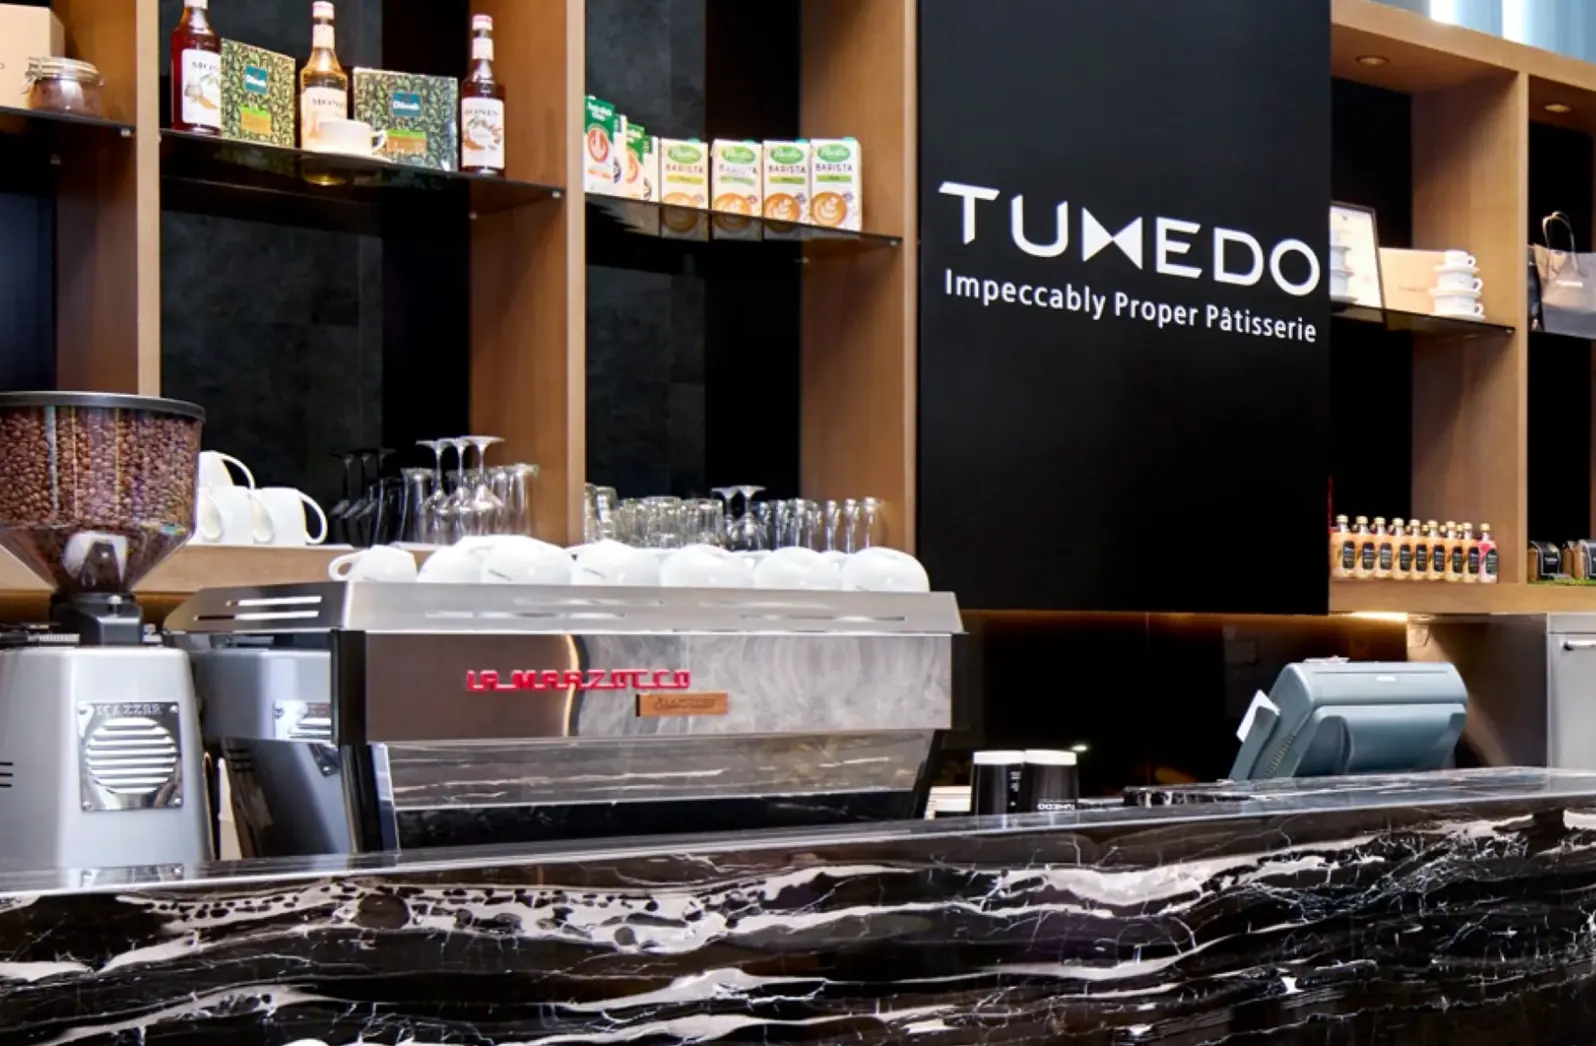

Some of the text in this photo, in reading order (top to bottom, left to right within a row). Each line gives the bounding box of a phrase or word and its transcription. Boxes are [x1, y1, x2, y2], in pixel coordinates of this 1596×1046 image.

[944, 269, 1318, 343] Impeccably Proper Pâtisserie
